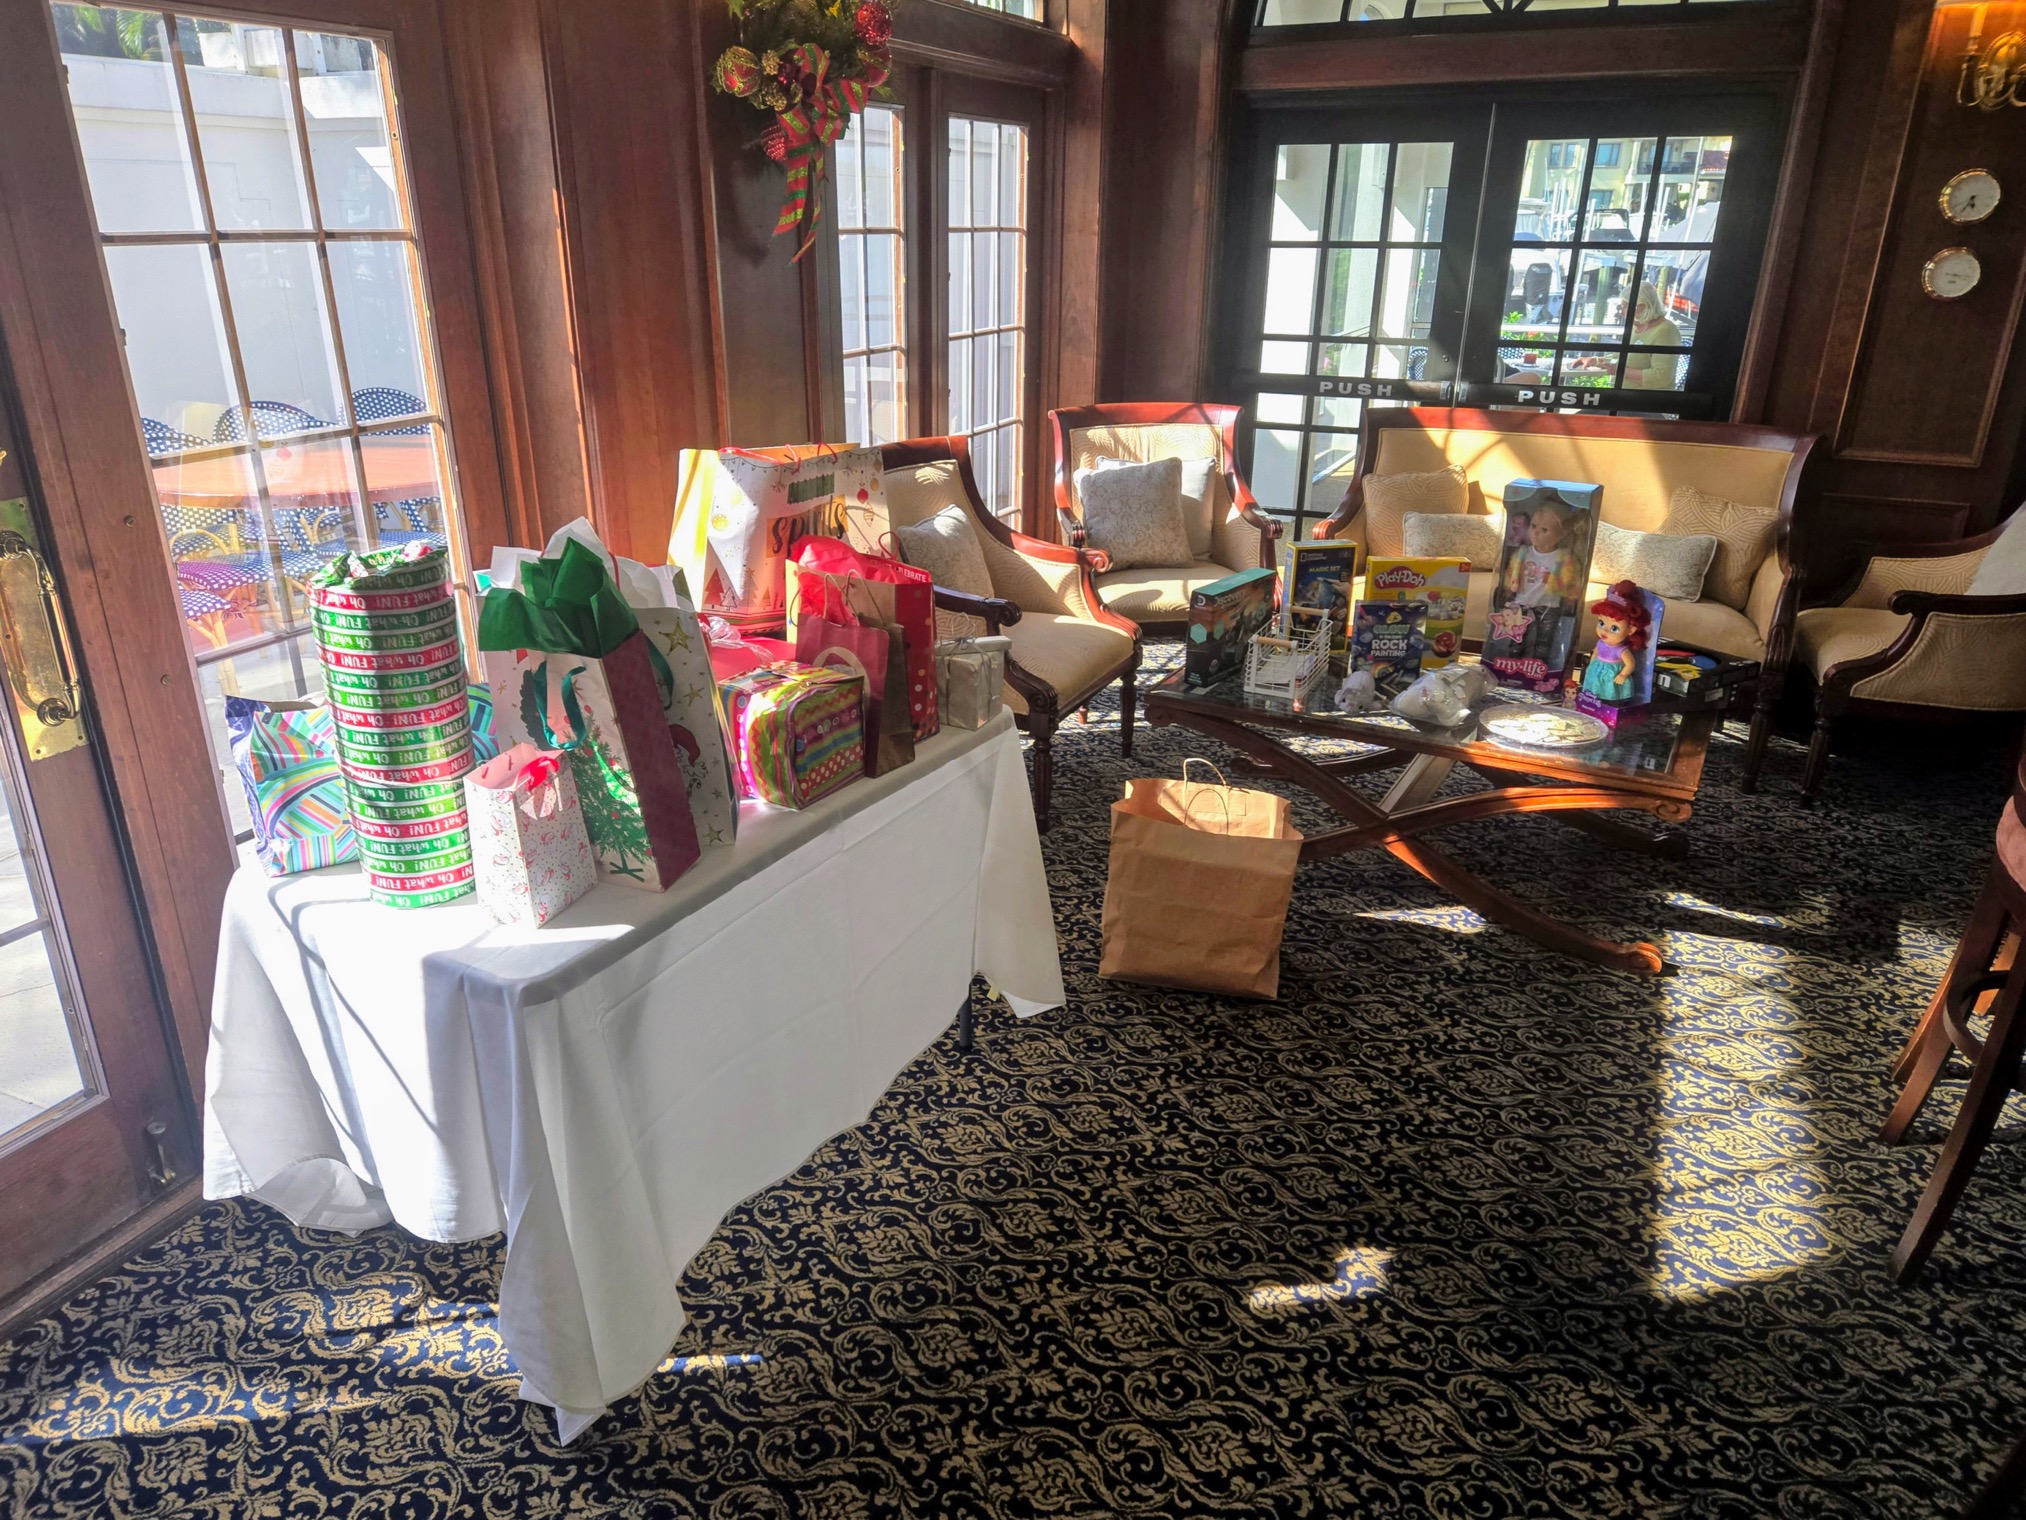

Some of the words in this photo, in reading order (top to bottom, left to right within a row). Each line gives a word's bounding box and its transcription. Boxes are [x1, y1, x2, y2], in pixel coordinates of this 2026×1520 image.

[1319, 381, 1392, 397] PUSH
[1517, 390, 1601, 406] PUSH
[350, 597, 366, 610] Oh
[376, 595, 409, 608] FUN!
[335, 614, 361, 628] FUN!
[403, 614, 419, 626] Oh
[426, 607, 448, 622] FUN!
[356, 637, 372, 649] Oh
[382, 635, 415, 648] FUN!
[1371, 639, 1408, 650] ROCK
[430, 645, 453, 661] FUN!
[341, 655, 367, 669] FUN!
[371, 656, 403, 669] what
[408, 654, 425, 666] Oh
[335, 673, 358, 685] what
[388, 674, 420, 686] FUN!
[424, 667, 447, 682] what
[362, 676, 378, 689] Oh
[437, 682, 457, 698] FUN!
[347, 693, 373, 708] FUN!
[377, 695, 408, 708] what
[413, 692, 430, 704] Oh
[342, 710, 364, 724] what
[429, 704, 452, 719] what
[367, 714, 384, 727] Oh
[394, 712, 425, 725] FUN!
[443, 720, 462, 736] FUN!
[352, 731, 379, 746] FUN!
[382, 732, 414, 745] what
[373, 752, 389, 764] Oh
[400, 750, 430, 762] FUN!
[448, 756, 468, 772] FUN!
[388, 769, 419, 782] what
[423, 766, 440, 778] Oh
[378, 789, 395, 801] Oh
[404, 786, 435, 799] FUN!
[364, 805, 390, 819] FUN!
[394, 806, 425, 819] what
[428, 802, 444, 815] Oh
[383, 825, 400, 837] Oh
[409, 822, 440, 835] FUN!
[369, 841, 396, 855] FUN!
[399, 841, 429, 854] what
[433, 838, 449, 850] Oh
[389, 861, 406, 873] Oh
[415, 858, 445, 872] FUN!
[375, 875, 401, 889] FUN!
[404, 876, 434, 889] what
[438, 873, 455, 884] Oh
[395, 896, 411, 908] Oh
[420, 890, 449, 905] FUN!
